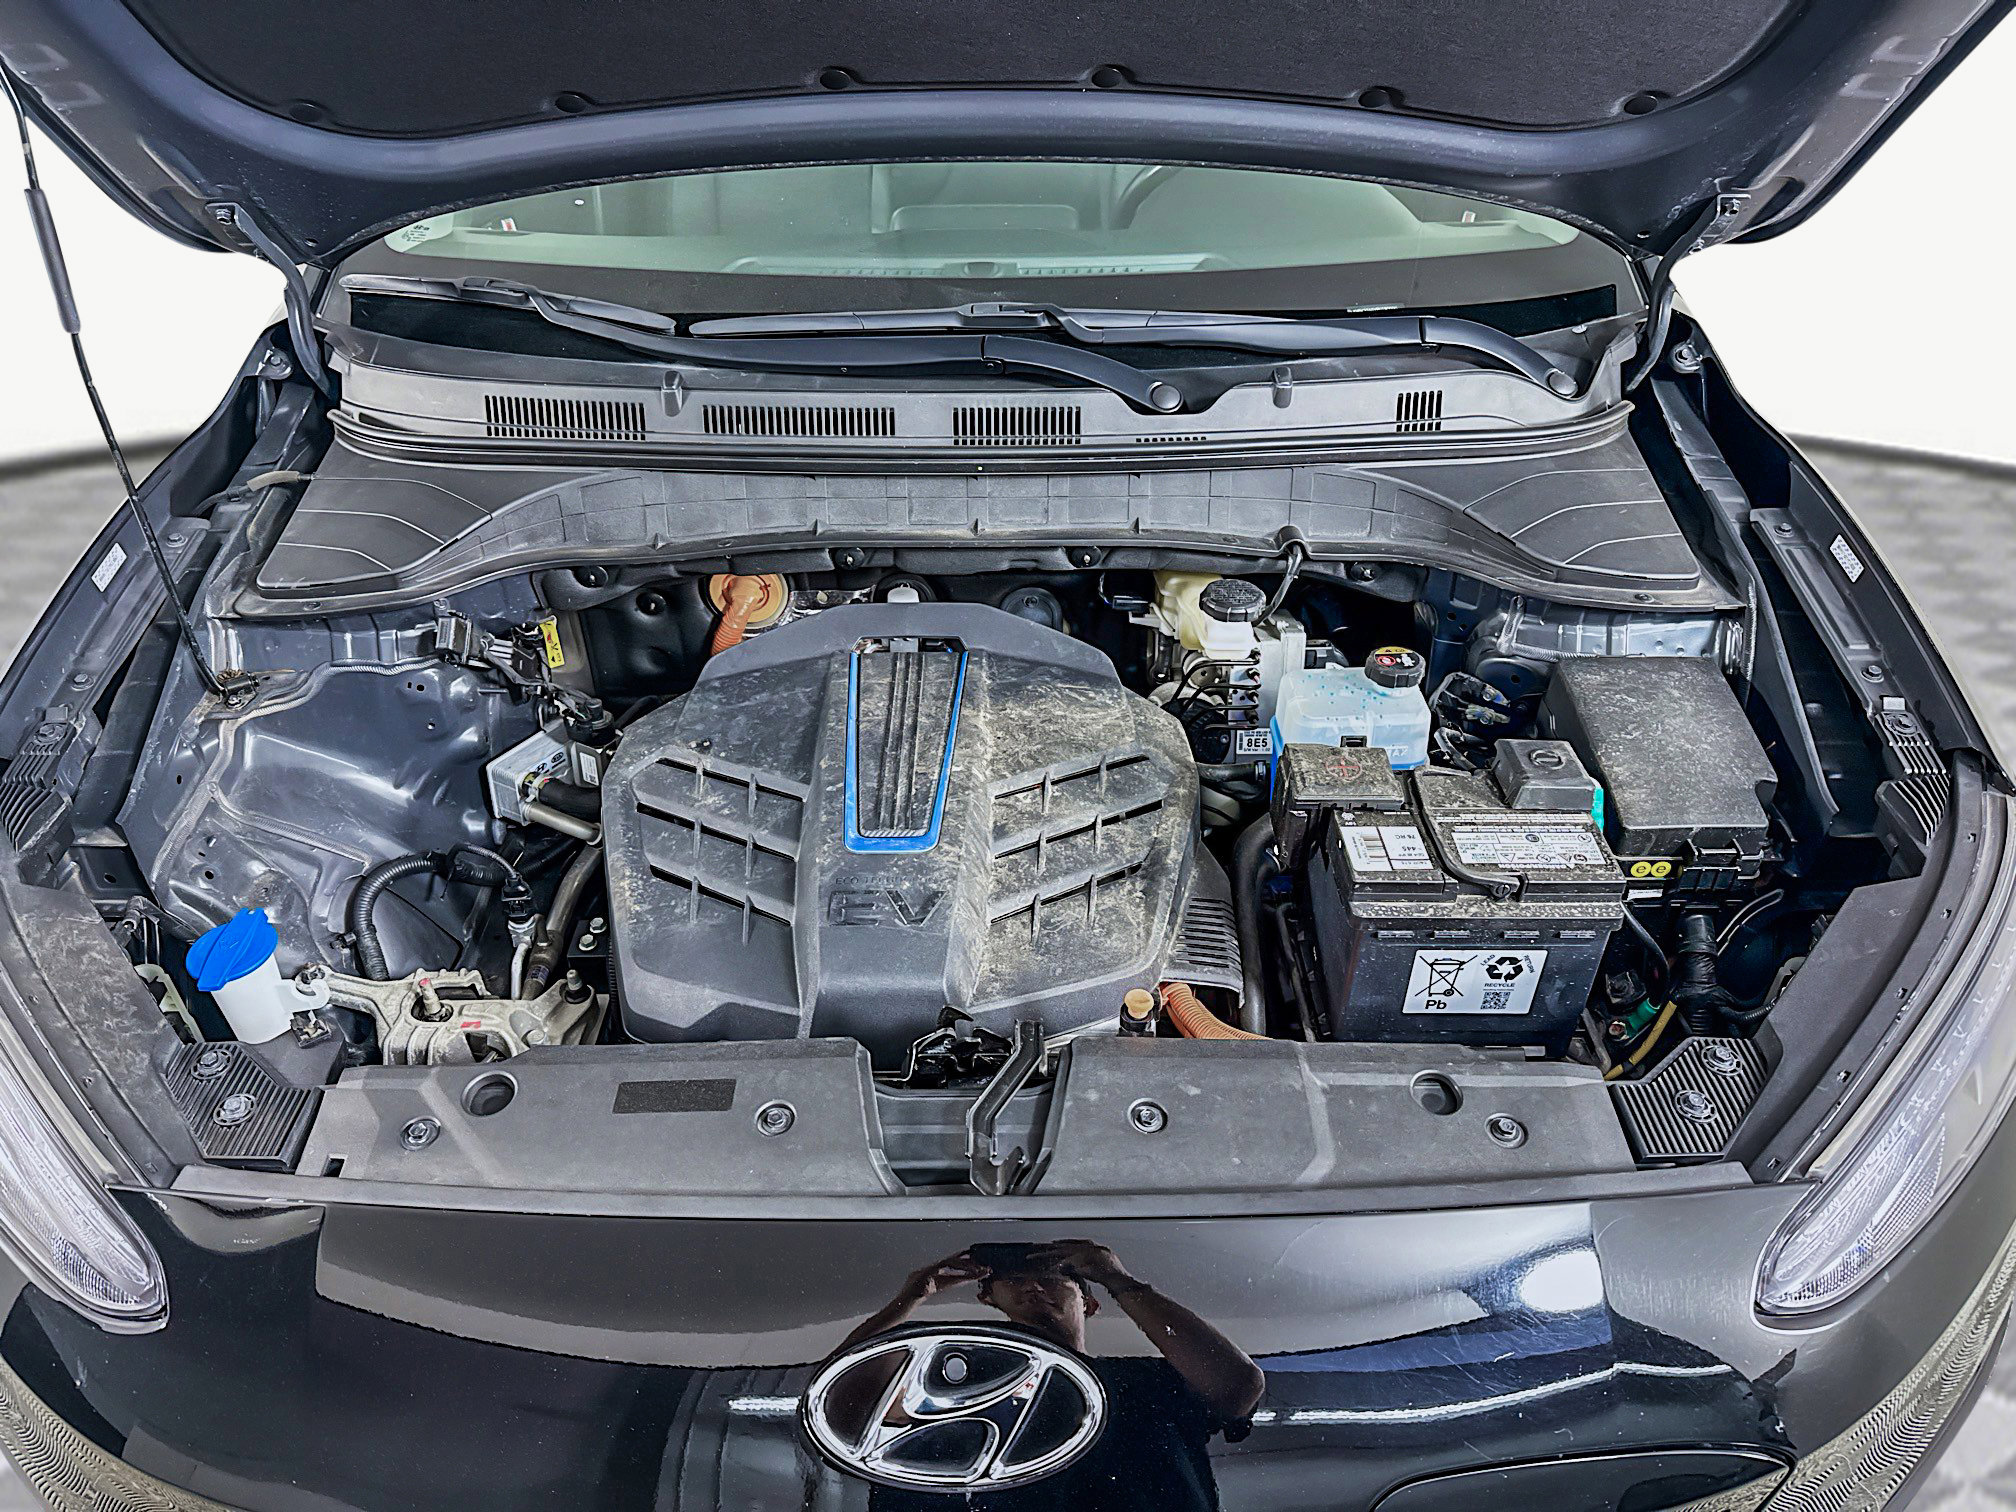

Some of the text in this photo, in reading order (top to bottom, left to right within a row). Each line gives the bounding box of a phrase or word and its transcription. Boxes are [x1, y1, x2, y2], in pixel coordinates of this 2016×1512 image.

[1246, 737, 1268, 748] 8E5
[827, 889, 948, 926] EV
[1480, 954, 1496, 966] LEAD
[1425, 999, 1447, 1010] Pb
